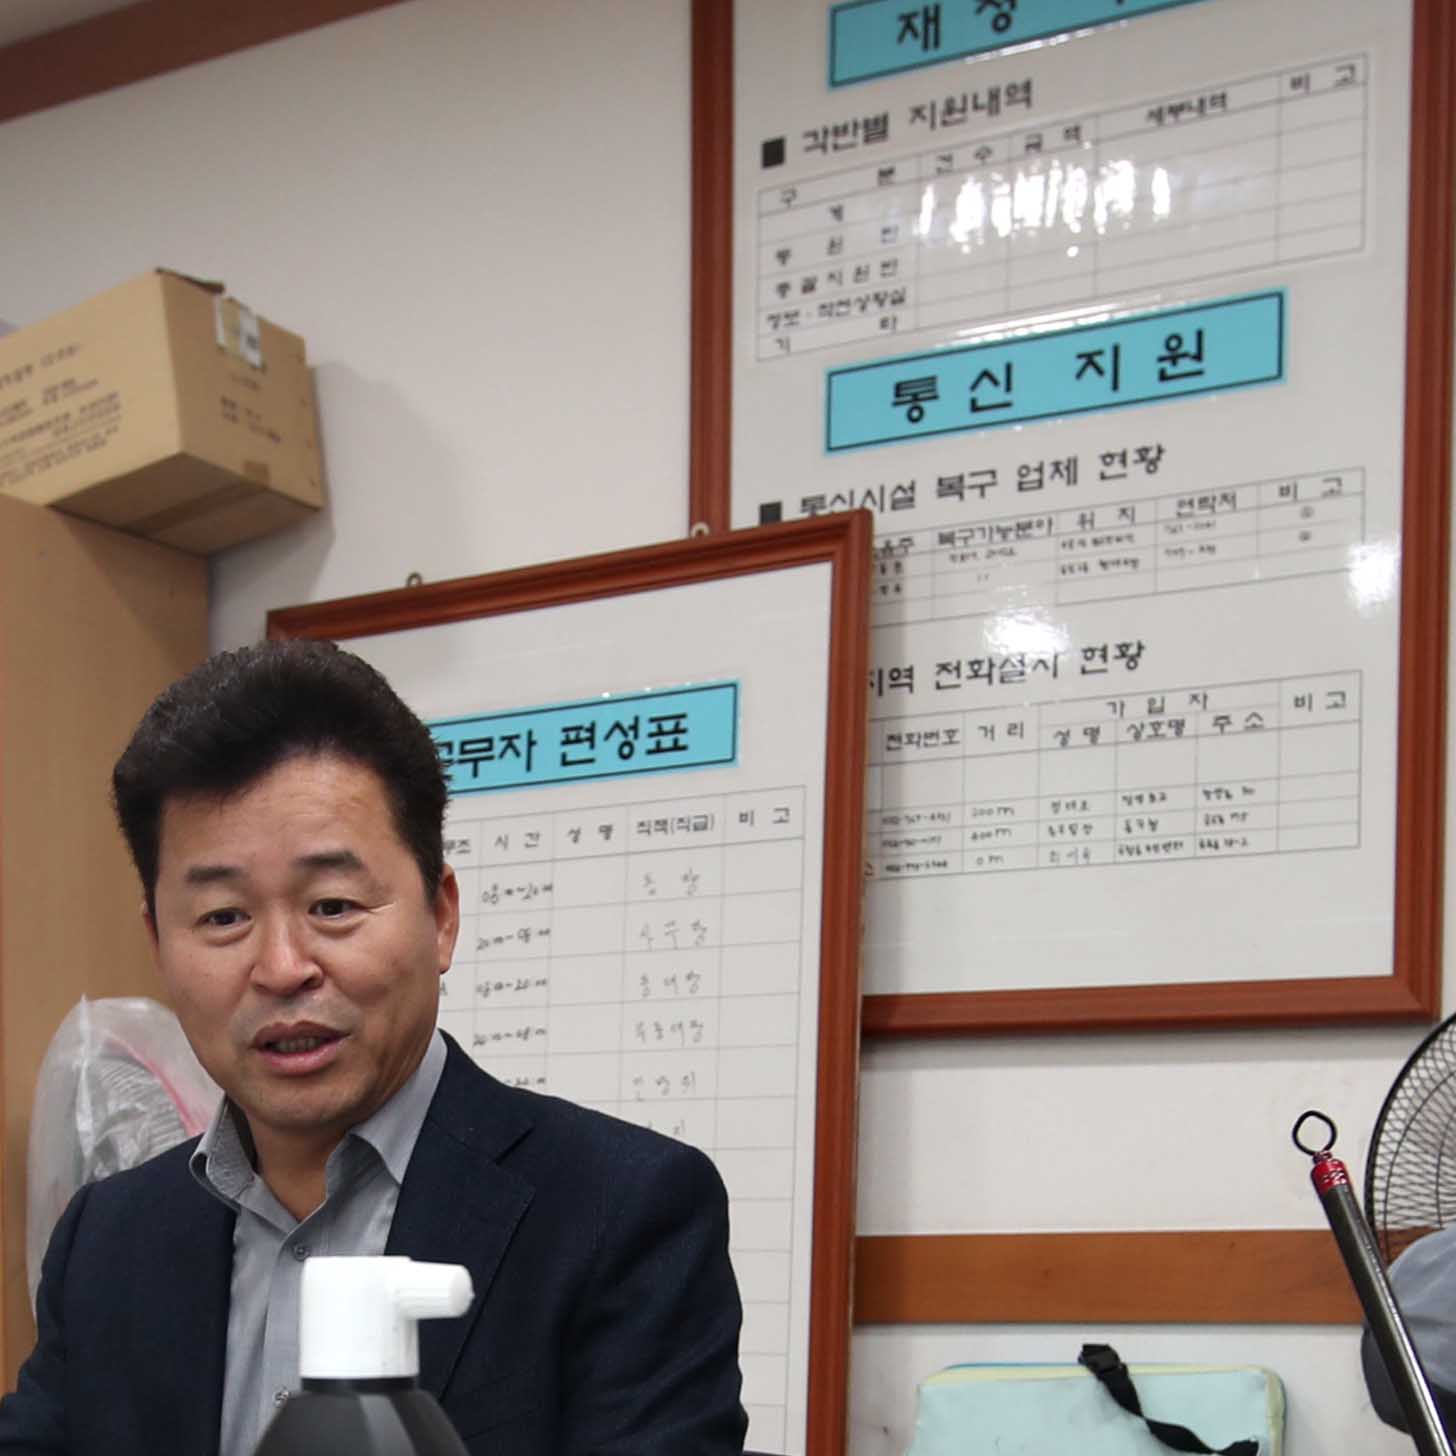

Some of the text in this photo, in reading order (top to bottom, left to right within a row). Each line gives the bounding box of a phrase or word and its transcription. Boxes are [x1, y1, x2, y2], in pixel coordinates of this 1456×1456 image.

[908, 78, 1033, 131] 지원내역
[890, 328, 1206, 424] 통신 지원
[935, 467, 1000, 502] 복구
[1097, 443, 1167, 482] 현황
[1079, 640, 1146, 676] 현황
[558, 711, 690, 768] 편성표
